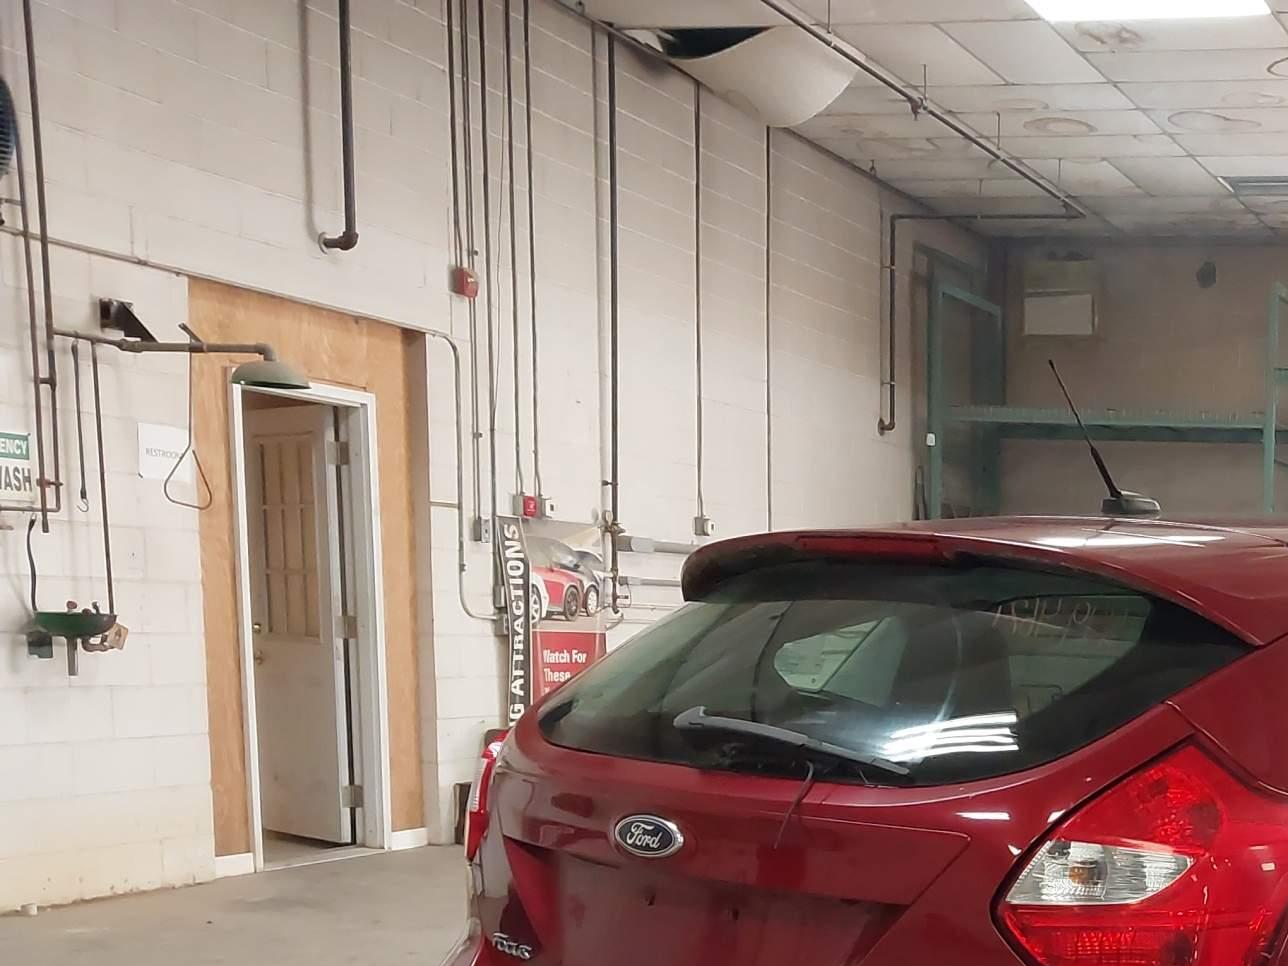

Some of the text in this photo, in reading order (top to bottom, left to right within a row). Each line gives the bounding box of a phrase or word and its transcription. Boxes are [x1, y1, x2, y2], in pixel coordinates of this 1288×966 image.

[503, 524, 525, 696] ATTRACTIONS
[571, 649, 588, 664] For
[543, 667, 571, 683] These
[626, 822, 663, 849] Ford
